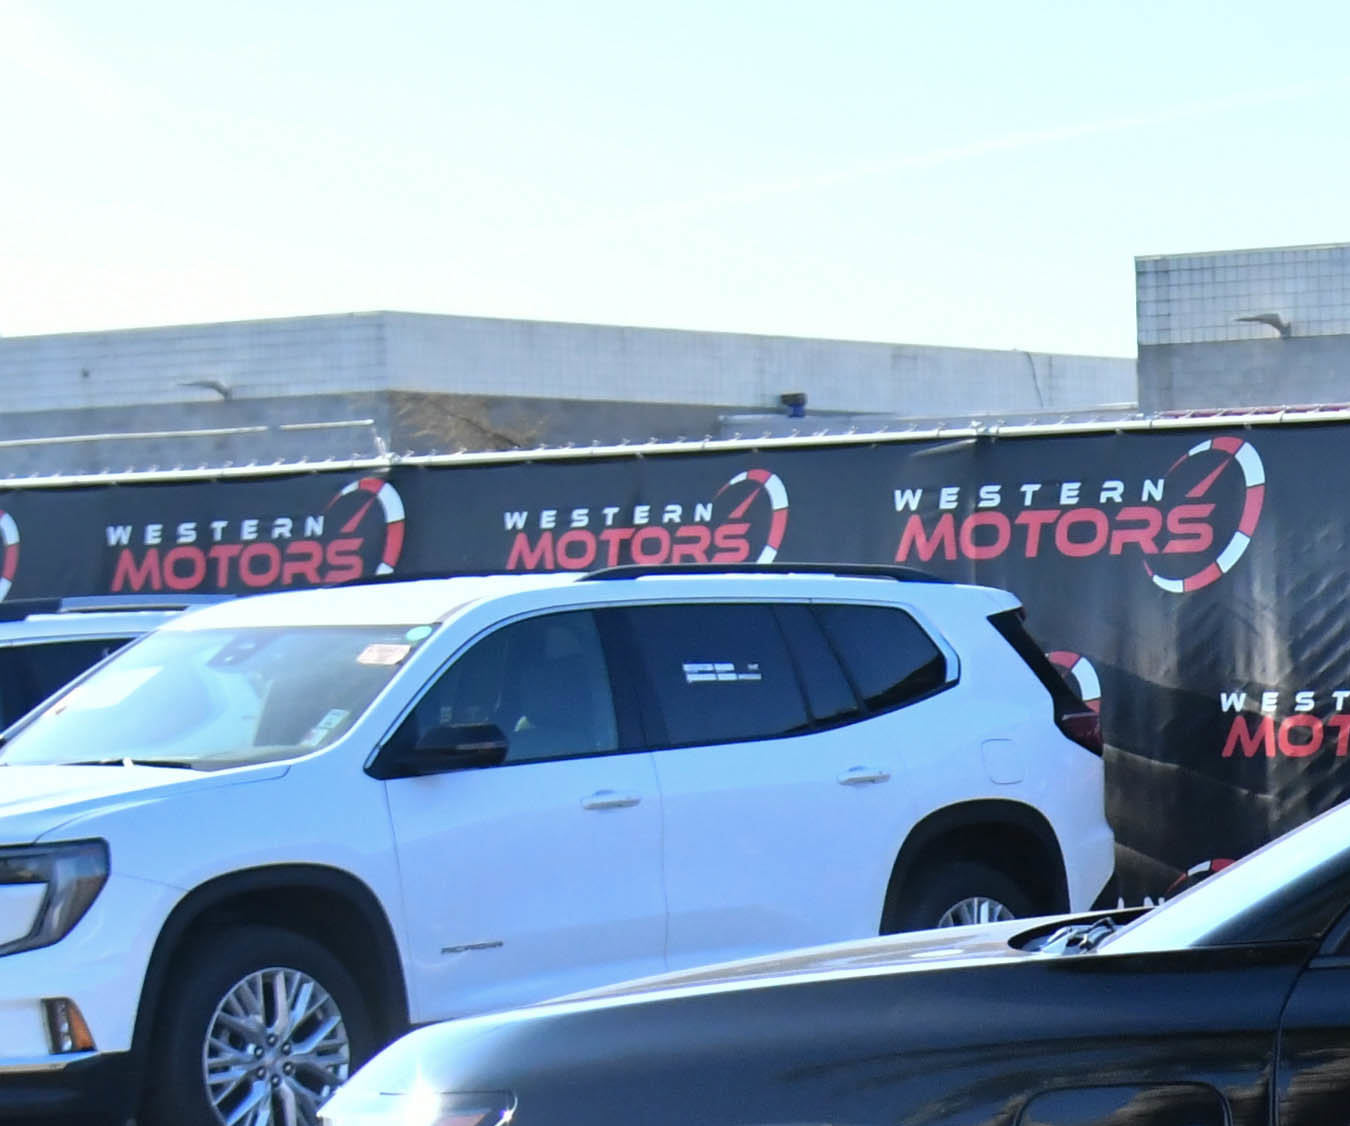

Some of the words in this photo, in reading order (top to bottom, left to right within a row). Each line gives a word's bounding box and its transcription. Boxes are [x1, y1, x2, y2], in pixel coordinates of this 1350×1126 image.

[895, 479, 1164, 511] WESTERN
[107, 516, 323, 545] WESTERN
[505, 504, 712, 530] WESTERN
[898, 504, 1214, 562] MOTORS
[112, 537, 365, 591] MOTORS
[510, 528, 748, 568] MOTORS
